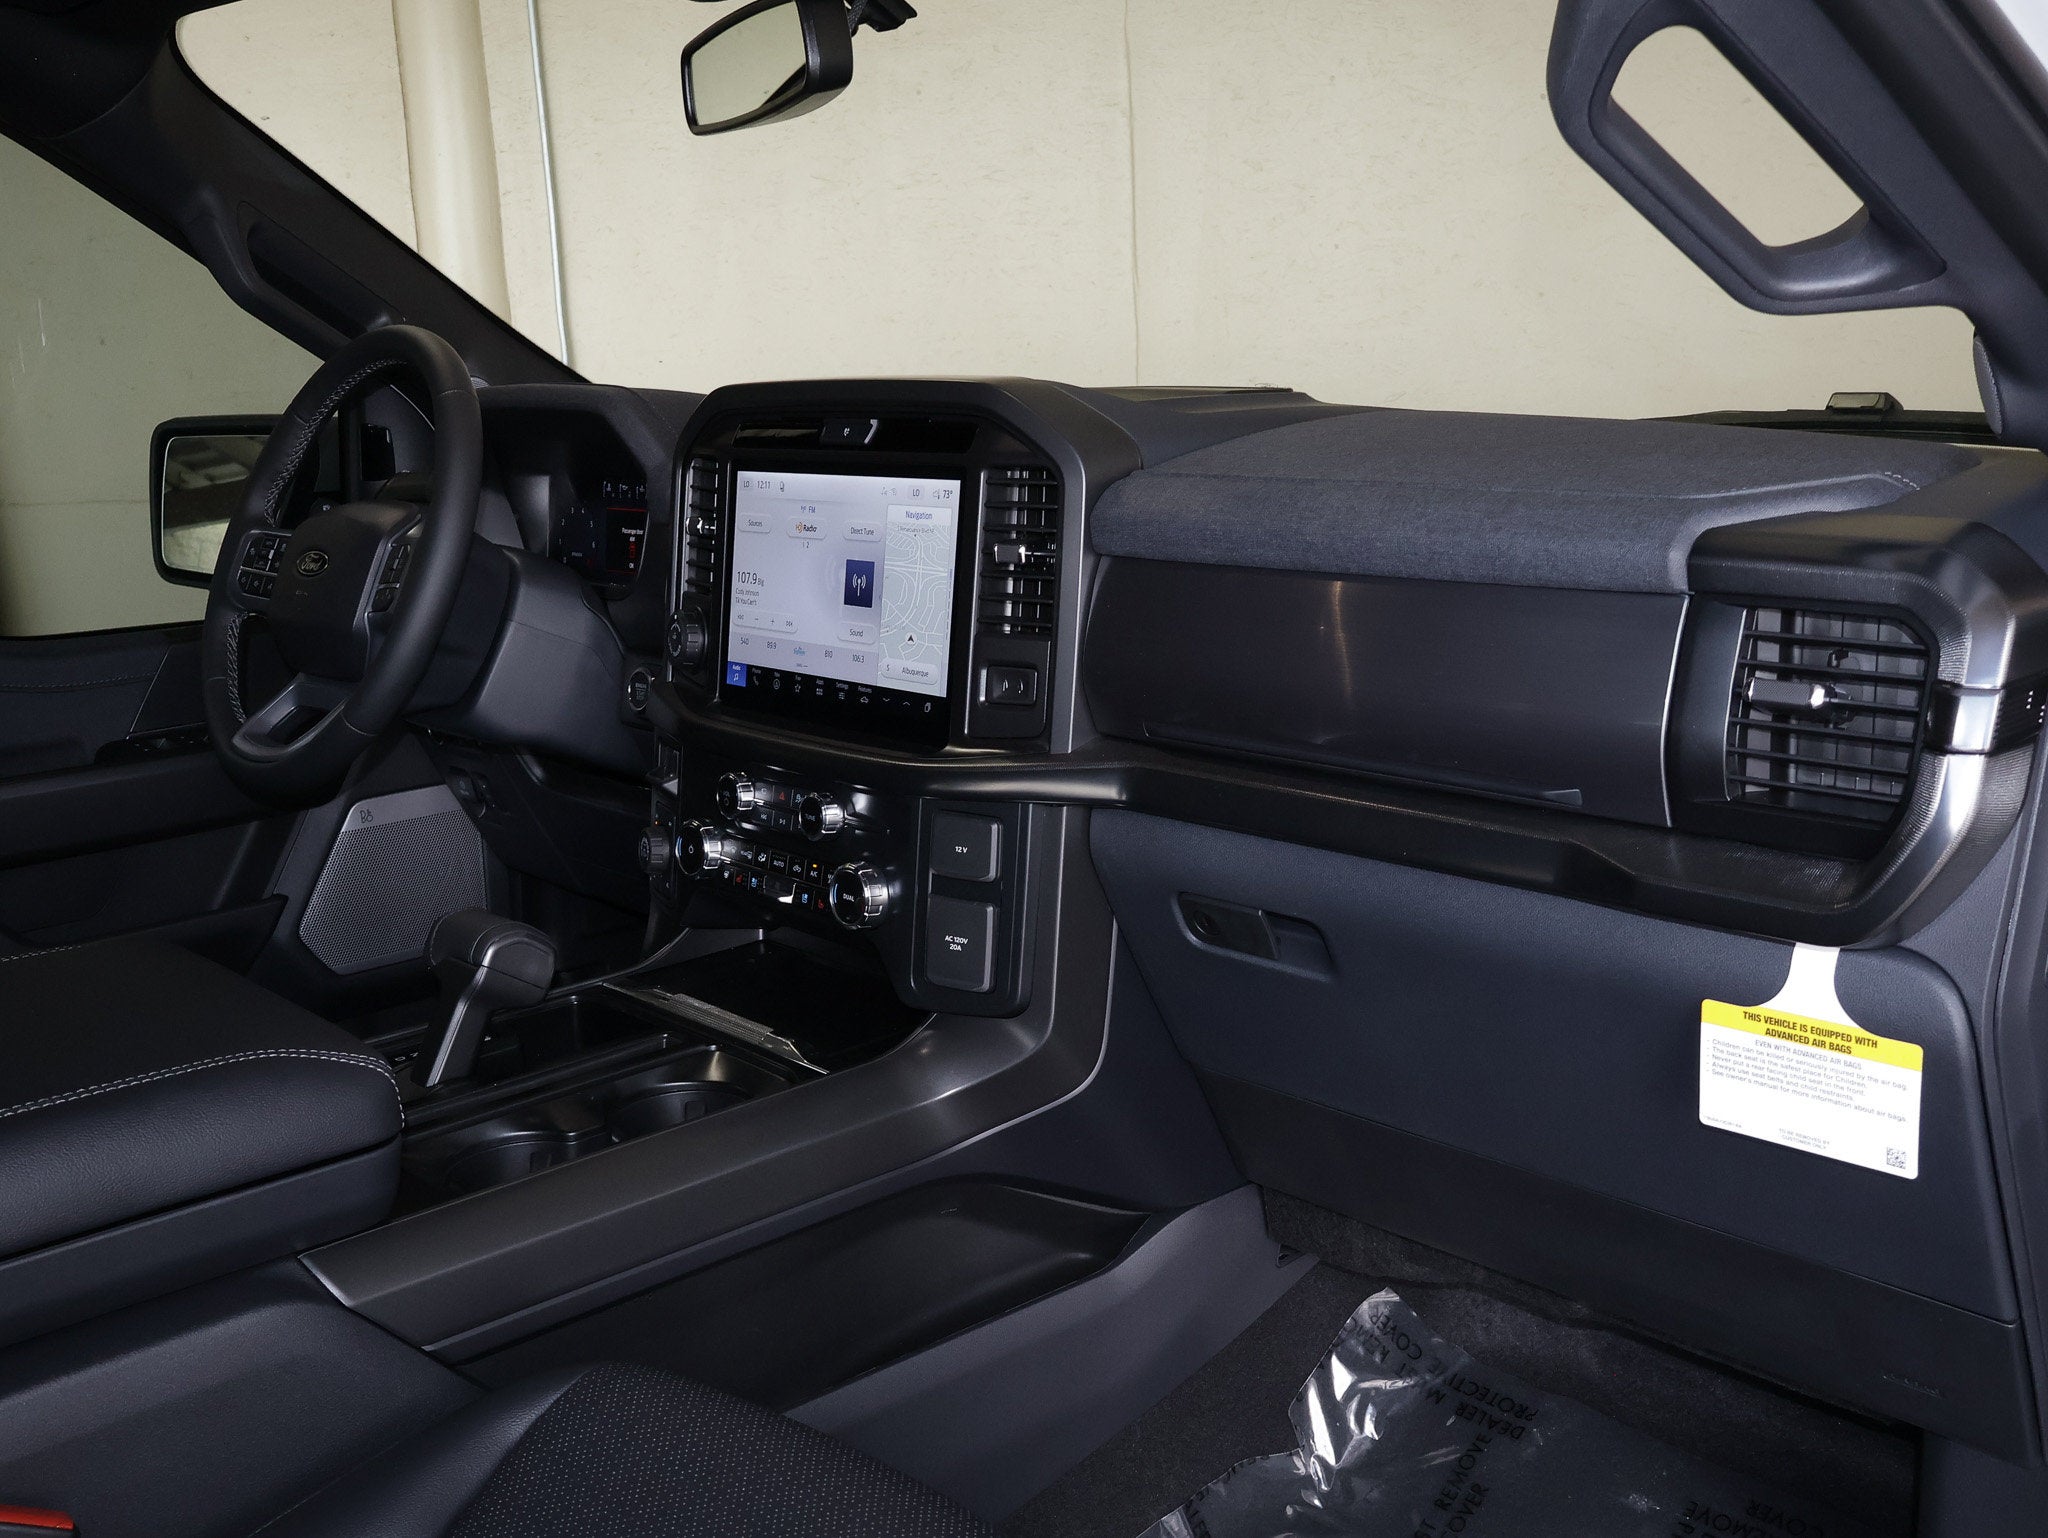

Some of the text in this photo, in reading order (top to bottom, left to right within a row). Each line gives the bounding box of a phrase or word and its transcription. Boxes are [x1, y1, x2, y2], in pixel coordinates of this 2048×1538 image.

[905, 511, 933, 521] Navigation
[863, 528, 875, 536] Tune
[737, 571, 758, 585] 107.9
[849, 629, 863, 637] Sound
[901, 667, 929, 678] Albuquerque
[773, 860, 785, 868] AUTO
[953, 936, 968, 944] 120V
[1743, 1011, 1878, 1048] THIS VEHICLE IS EQUIPPED WITH
[1765, 1028, 1852, 1055] ADVANCED AIR BAGS
[1712, 1038, 1741, 1050] Children
[1766, 1051, 1785, 1061] killed
[1829, 1066, 1855, 1078] injured
[1856, 1073, 1865, 1081] by
[1867, 1075, 1879, 1084] the
[1712, 1046, 1725, 1054] The
[1726, 1049, 1742, 1058] back
[1767, 1059, 1778, 1067] the
[1803, 1068, 1822, 1078] place
[1755, 1039, 1862, 1070] EVEN WITH ADVANCED AIR BAGS
[1712, 1053, 1731, 1063] Never
[1766, 1067, 1788, 1078] facing
[1789, 1073, 1807, 1082] child
[1833, 1083, 1845, 1091] the
[1712, 1061, 1736, 1073] Always
[1785, 1080, 1799, 1088] and
[1800, 1083, 1818, 1092] child
[1712, 1068, 1724, 1077] See
[1753, 1079, 1779, 1090] manual
[1791, 1090, 1809, 1098] more
[1811, 1094, 1852, 1109] information
[1853, 1105, 1875, 1114] about
[1368, 1309, 1422, 1360] COVER
[1455, 1401, 1526, 1440] DEALER
[1434, 1432, 1492, 1512] REMOVE
[1441, 1484, 1489, 1538] OVER
